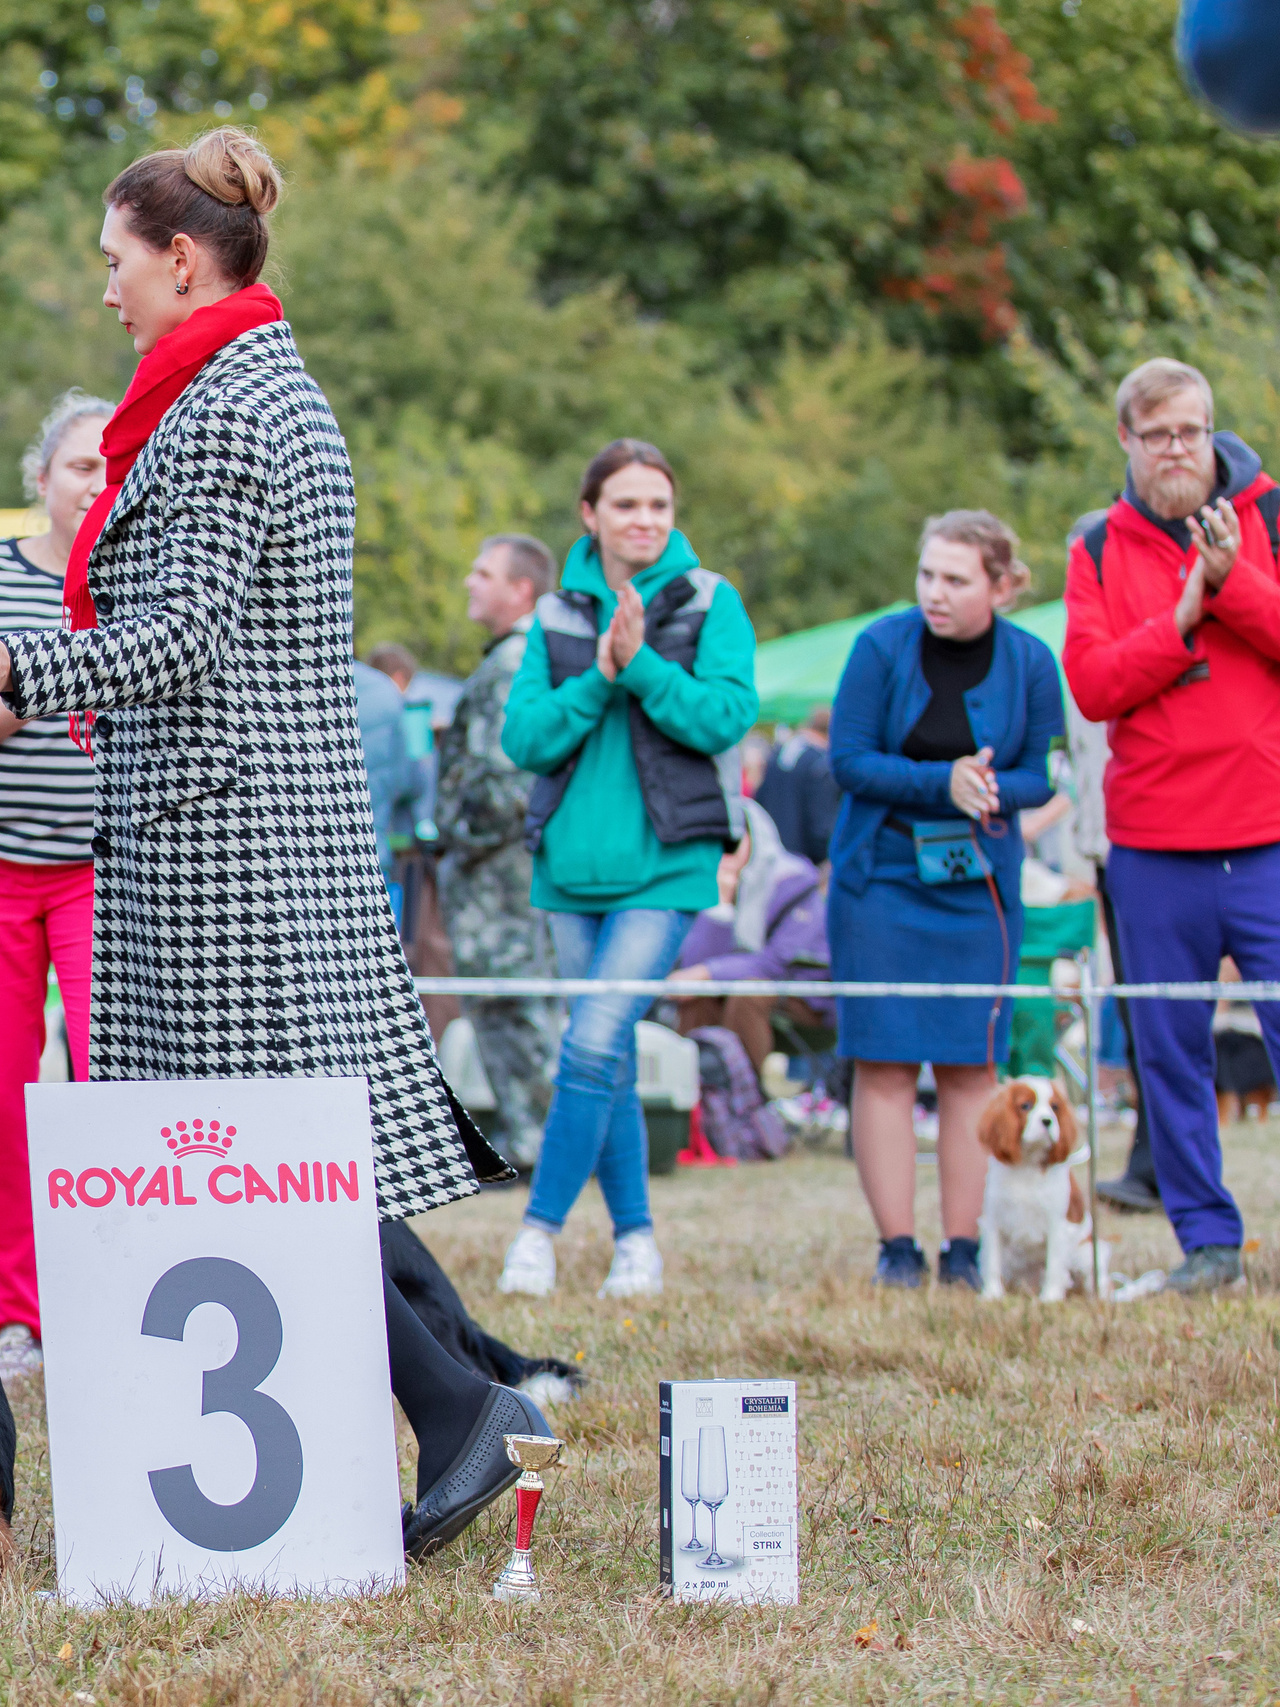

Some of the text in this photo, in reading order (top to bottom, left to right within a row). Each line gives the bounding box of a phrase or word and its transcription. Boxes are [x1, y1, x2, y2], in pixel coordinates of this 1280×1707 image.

[47, 1160, 360, 1208] ROYAL CANIN
[140, 1256, 304, 1552] 3
[744, 1397, 786, 1405] CRYSTALITE
[748, 1404, 783, 1412] BOHEMIA
[749, 1530, 785, 1538] Collection
[752, 1541, 782, 1550] STRIX
[684, 1581, 690, 1589] 2
[700, 1580, 716, 1589] 200
[718, 1580, 729, 1588] ml
